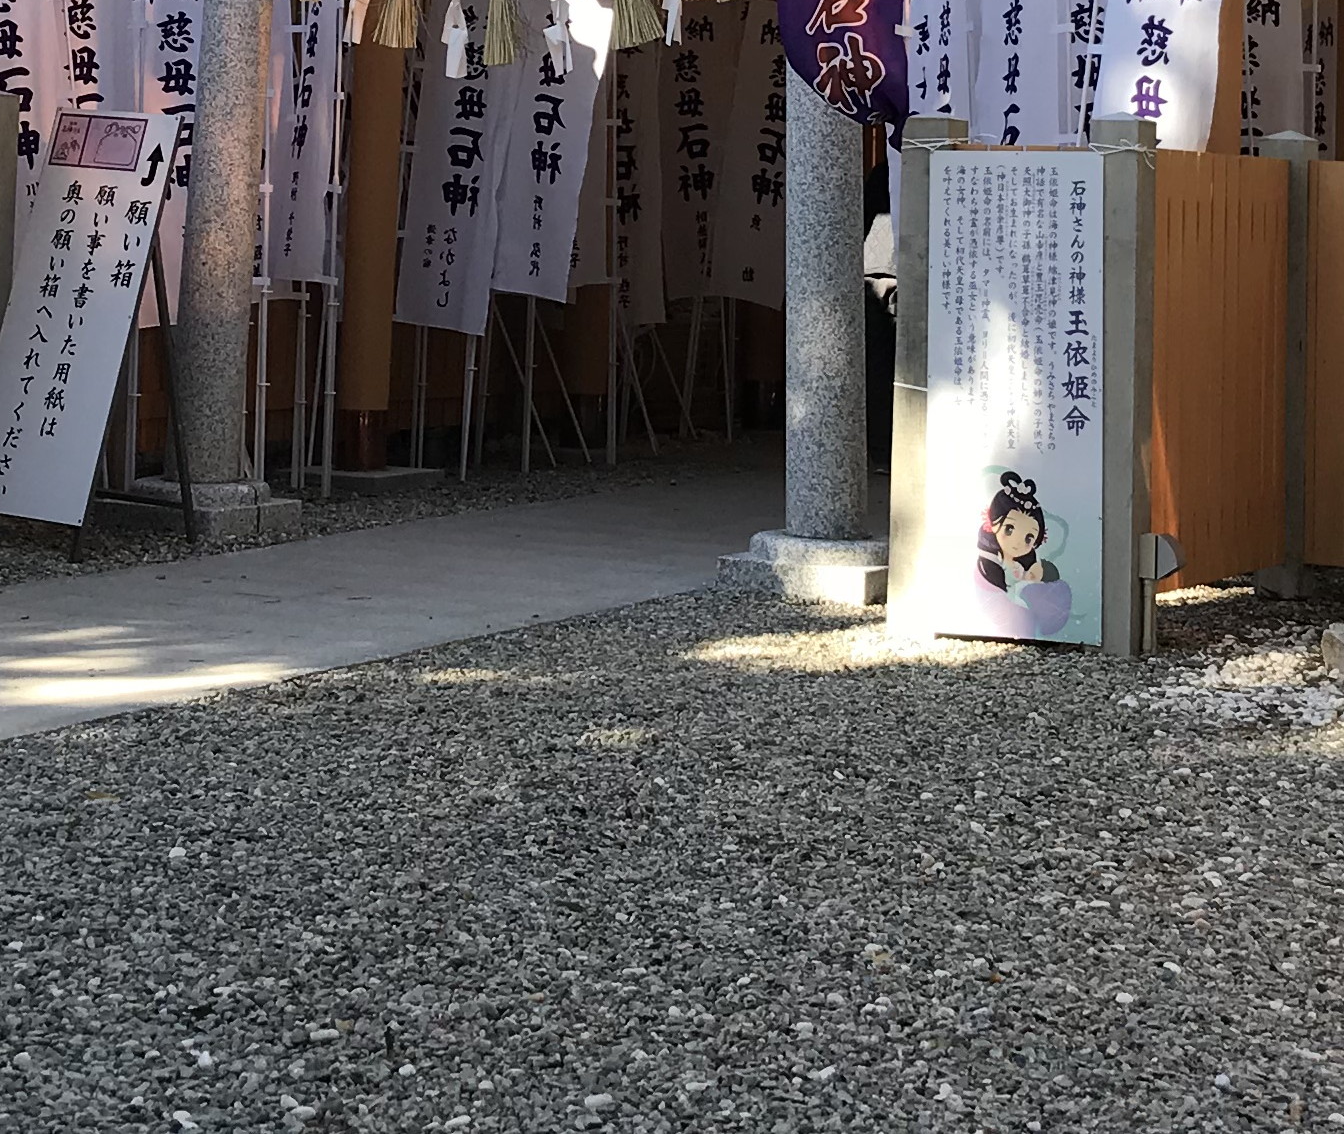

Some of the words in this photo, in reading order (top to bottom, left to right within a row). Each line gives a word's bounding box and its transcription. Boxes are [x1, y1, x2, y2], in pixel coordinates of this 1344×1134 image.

[672, 49, 716, 204] 慈母石神
[38, 184, 120, 438] 願い事を書いた用紙は
[109, 198, 153, 290] 願い箱
